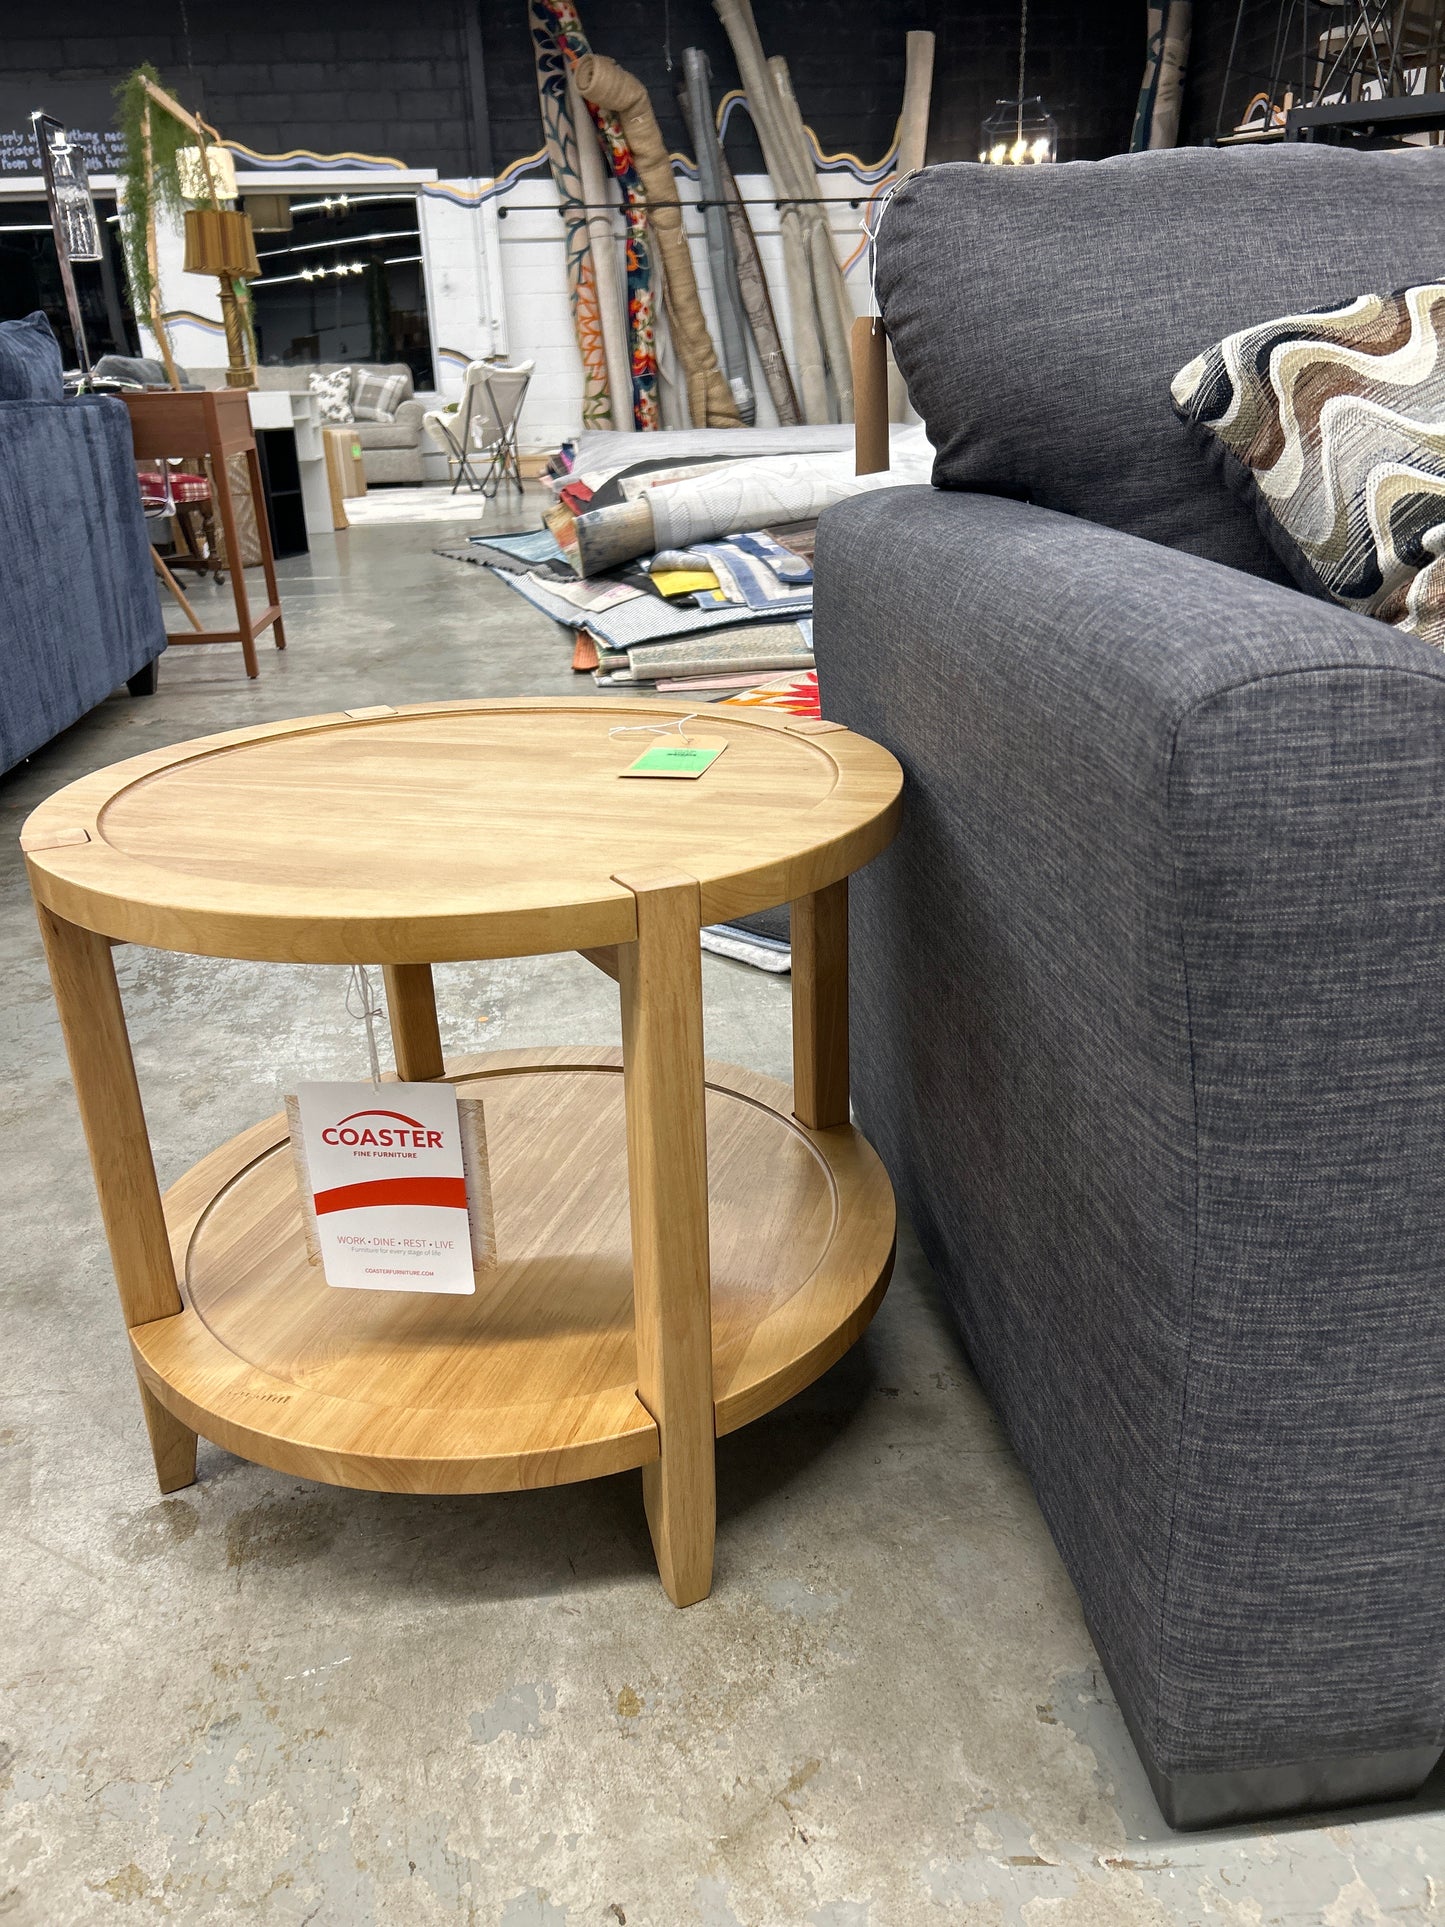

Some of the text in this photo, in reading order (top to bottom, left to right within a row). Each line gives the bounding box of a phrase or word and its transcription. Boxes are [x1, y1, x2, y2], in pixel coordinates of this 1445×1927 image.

[321, 1128, 444, 1149] COASTER
[373, 1151, 417, 1159] FURNITURE
[337, 1236, 454, 1249] WORK DINE REST LIVE
[351, 1246, 379, 1254] Furniture
[365, 1267, 435, 1277] COASTERFURNITURE.COM
